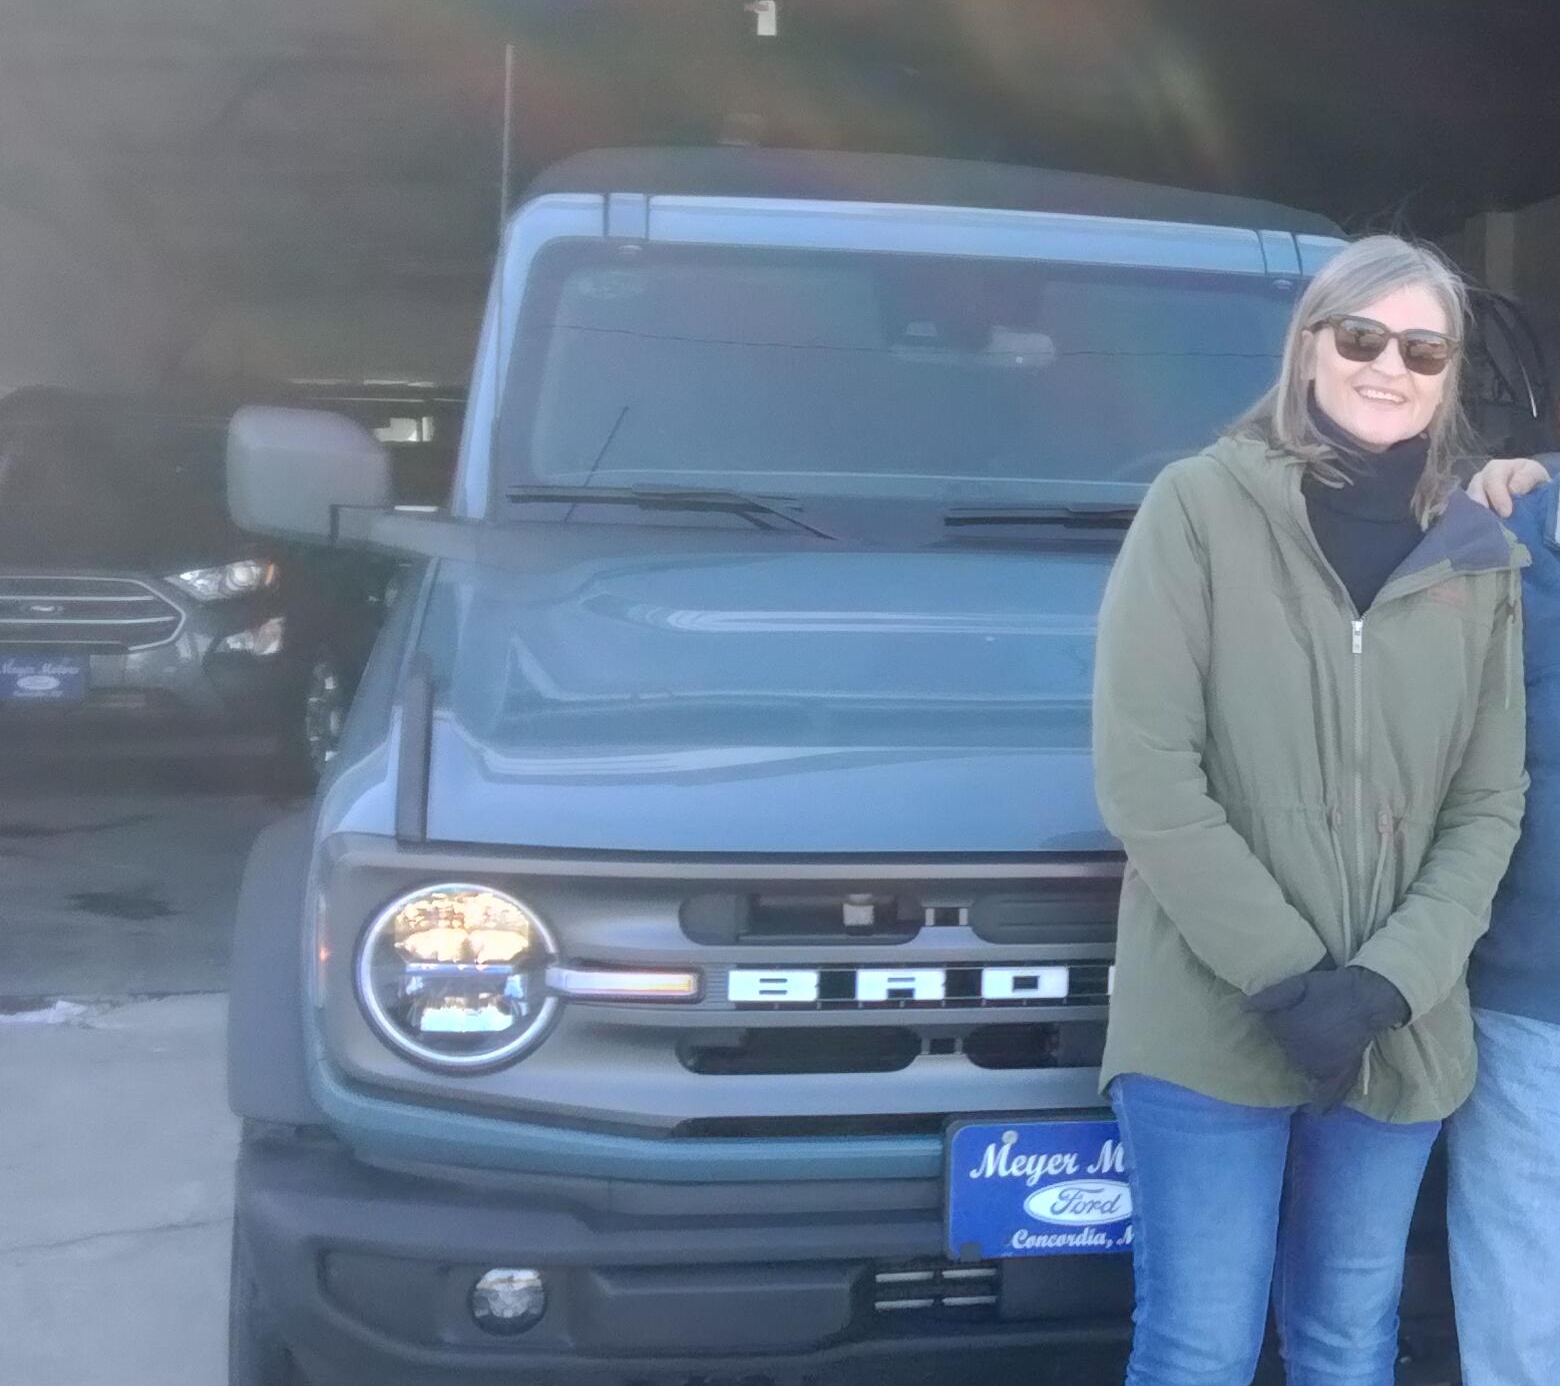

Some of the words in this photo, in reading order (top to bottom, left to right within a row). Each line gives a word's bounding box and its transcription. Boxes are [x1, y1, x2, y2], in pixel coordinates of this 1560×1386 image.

[728, 966, 1115, 1002] BRO
[969, 1142, 1080, 1187] Meyer
[1051, 1187, 1123, 1216] Ford
[1011, 1226, 1114, 1250] Concordia,
